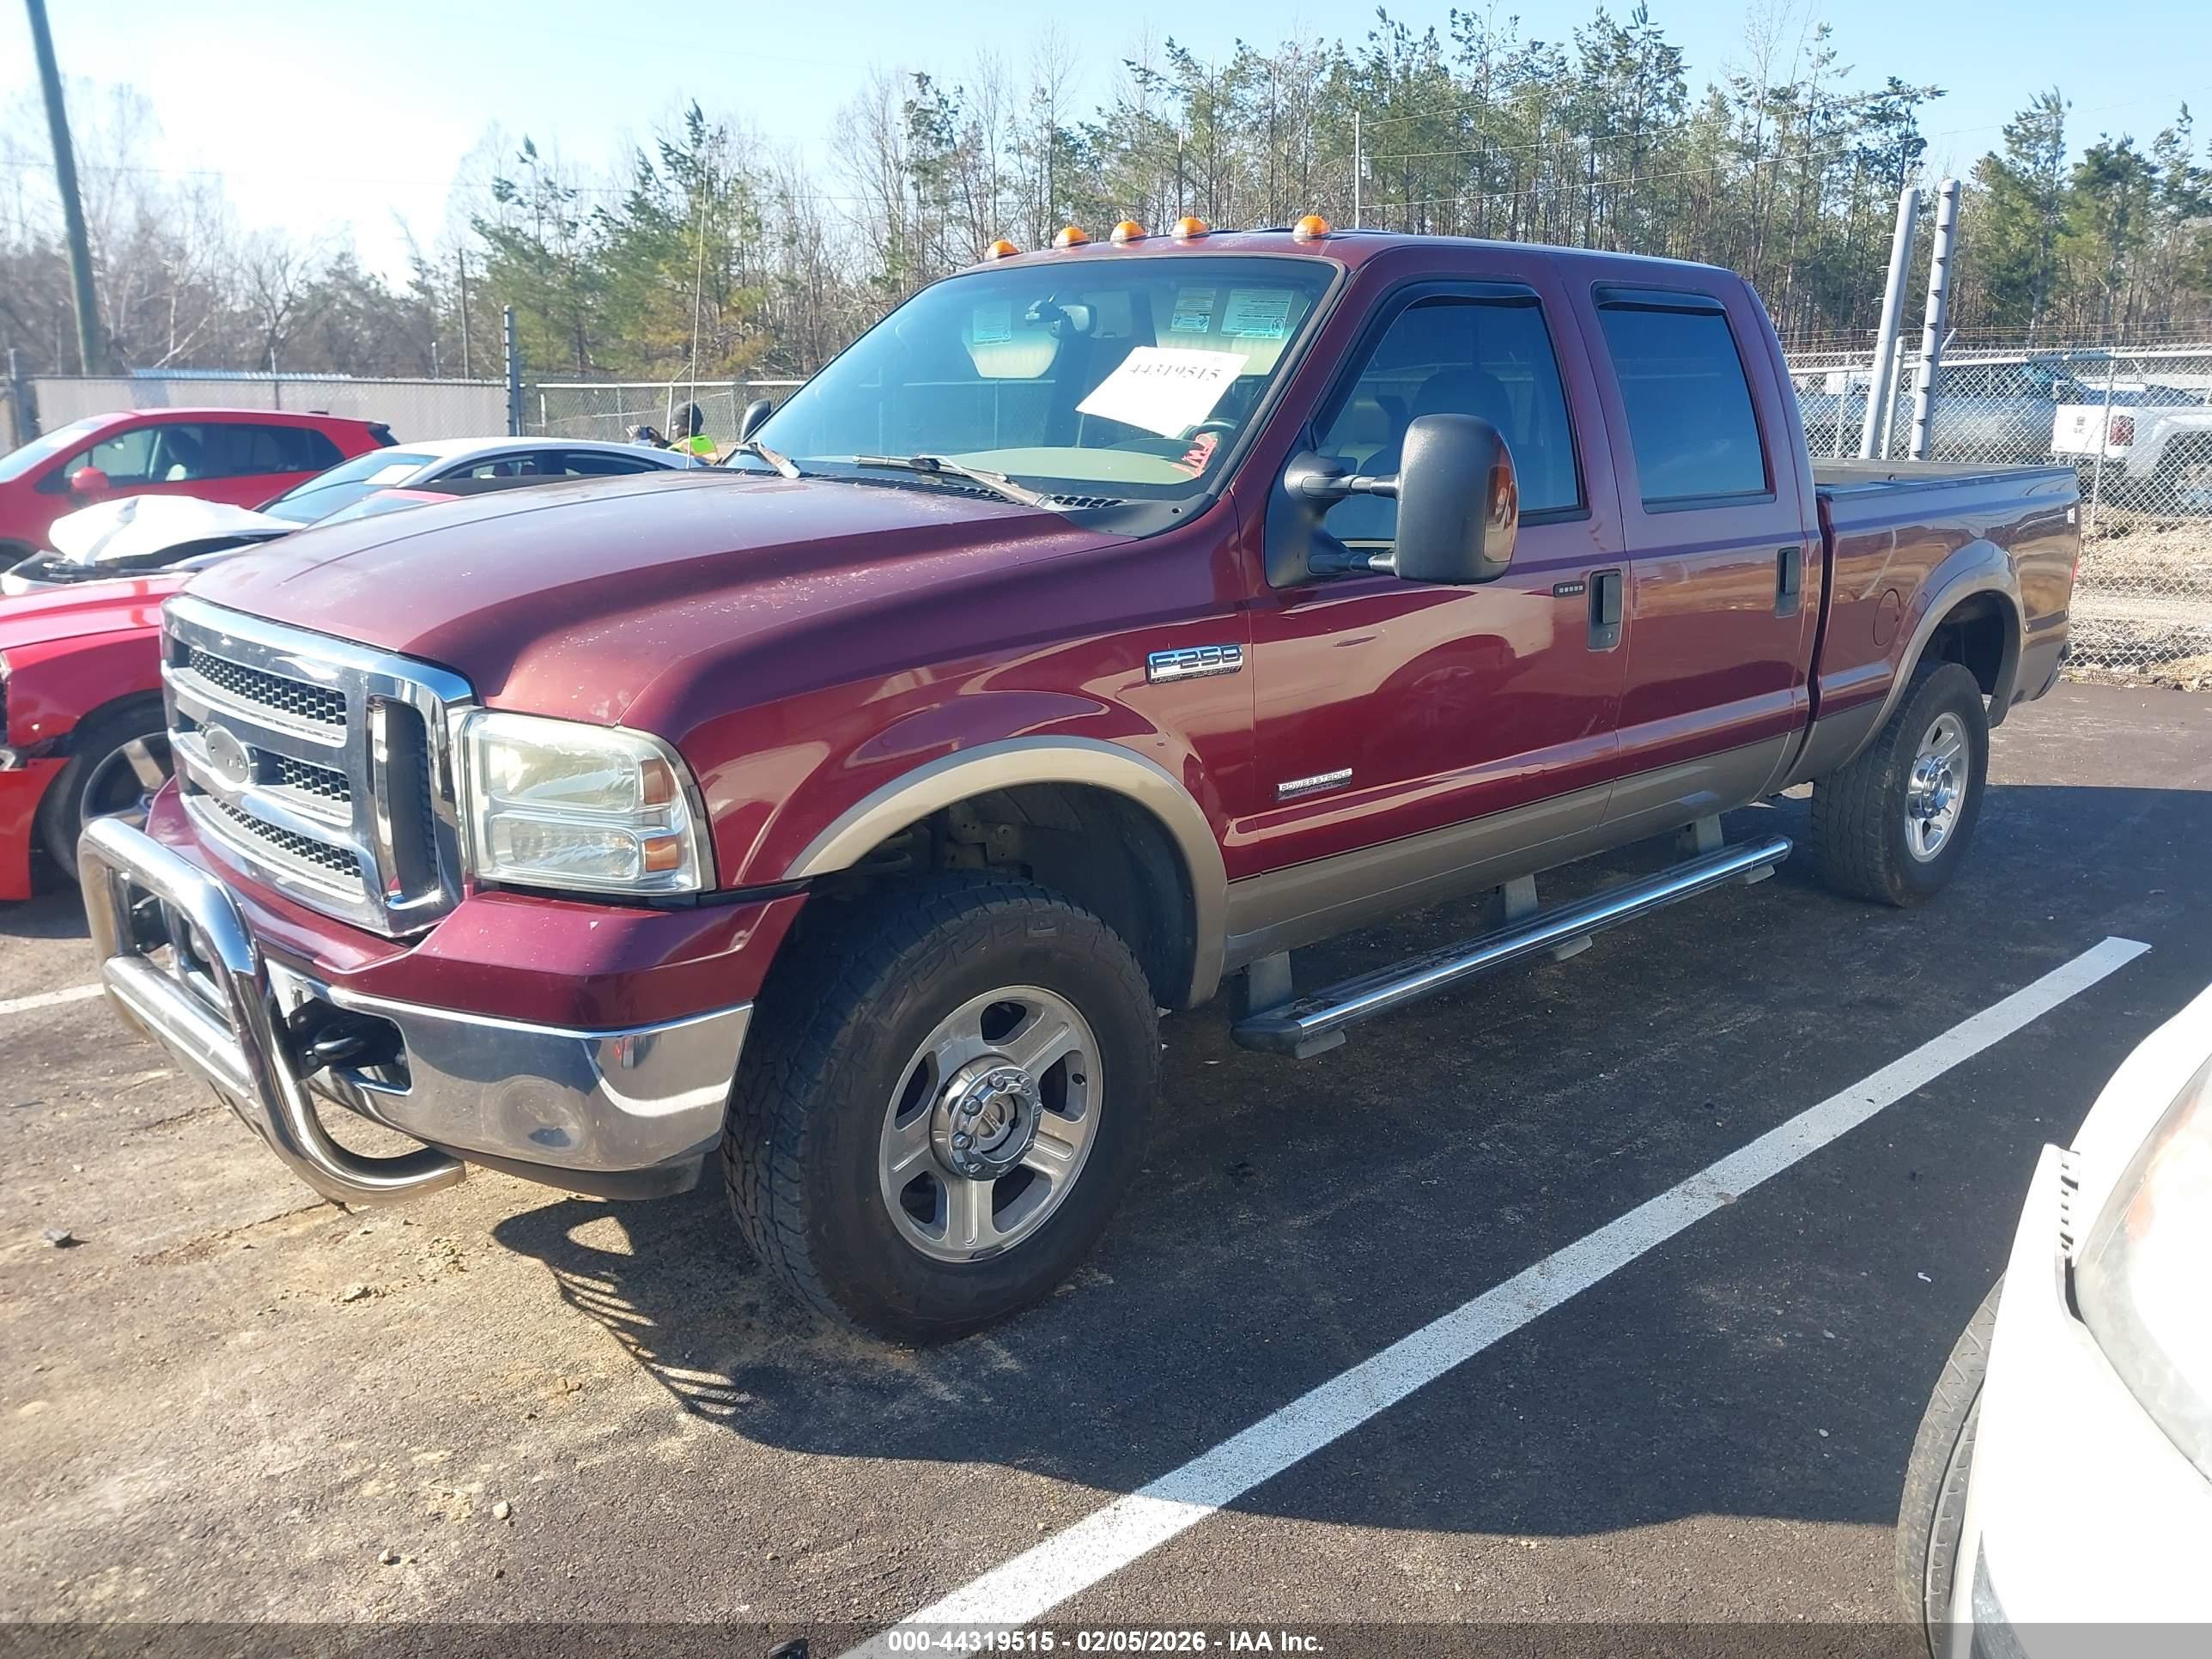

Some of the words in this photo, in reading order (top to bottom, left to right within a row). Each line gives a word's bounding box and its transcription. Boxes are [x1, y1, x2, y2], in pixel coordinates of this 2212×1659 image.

[1129, 363, 1221, 380] 44319515
[1152, 645, 1241, 673] F-250
[1281, 779, 1315, 790] POWER
[1316, 770, 1351, 783] STROKE
